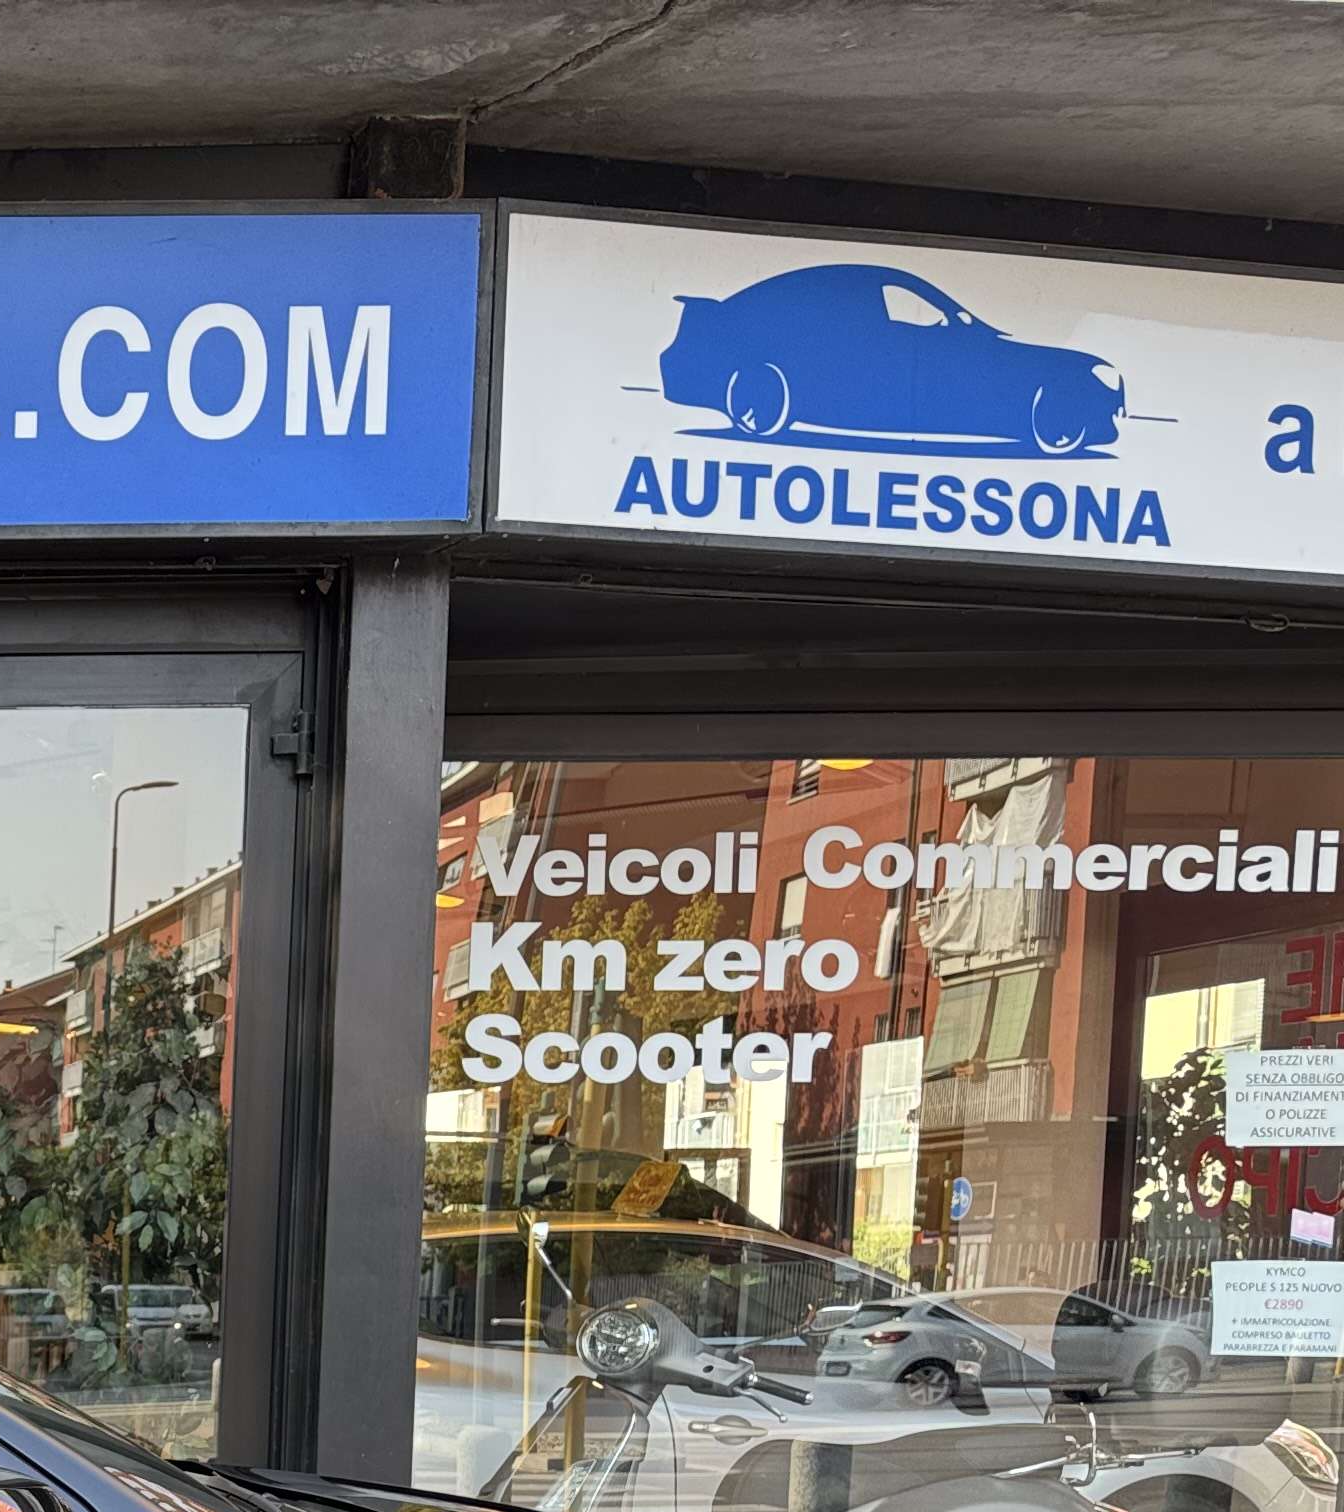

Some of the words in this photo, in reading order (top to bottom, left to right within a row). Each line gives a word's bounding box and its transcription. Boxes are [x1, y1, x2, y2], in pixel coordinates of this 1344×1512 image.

[614, 456, 1172, 548] AUTOLESSONA
[477, 829, 759, 898] Veicoli
[802, 825, 1339, 893] Commerciali
[467, 921, 626, 993] Km
[656, 935, 861, 994] zero
[462, 1014, 833, 1086] Scooter
[1260, 1055, 1303, 1066] PREZZI
[1306, 1055, 1334, 1066] VERI
[1245, 1073, 1287, 1084] SENZA
[1290, 1072, 1344, 1084] OBBLIGO
[1235, 1091, 1249, 1102] DI
[1265, 1109, 1275, 1120] O
[1279, 1109, 1328, 1120] POLIZZE
[1249, 1127, 1336, 1138] ASSICURATIVE
[1265, 1266, 1307, 1277] KYMCO
[1224, 1282, 1267, 1292] PEOPLE
[1269, 1282, 1276, 1292] S
[1279, 1282, 1299, 1292] 125
[1302, 1282, 1342, 1293] NUOVO
[1264, 1298, 1304, 1310] €2890
[1231, 1330, 1282, 1340] COMPRESO
